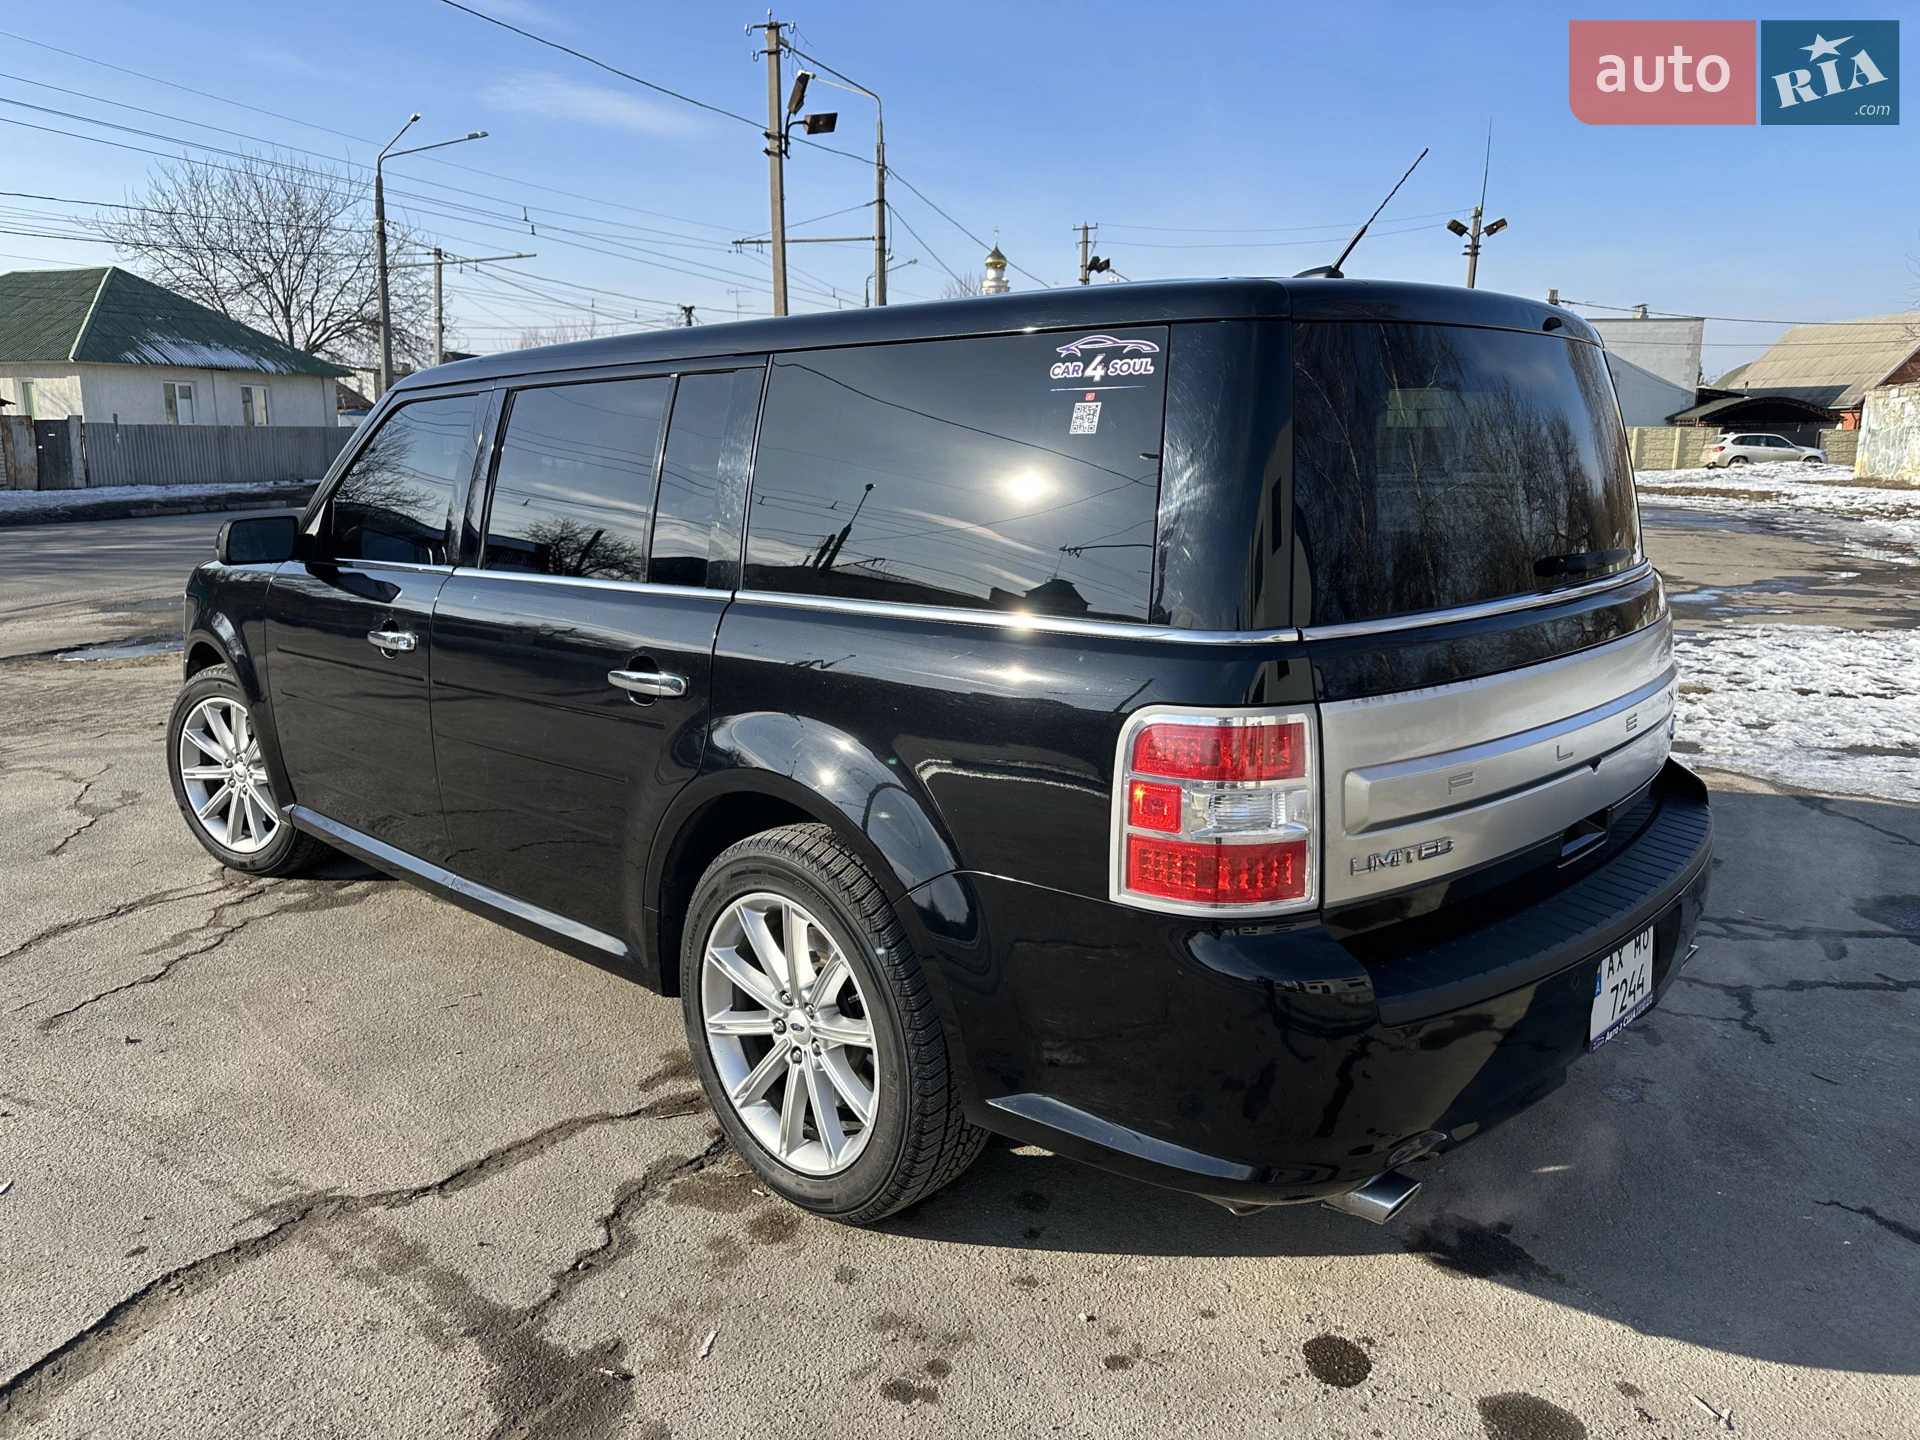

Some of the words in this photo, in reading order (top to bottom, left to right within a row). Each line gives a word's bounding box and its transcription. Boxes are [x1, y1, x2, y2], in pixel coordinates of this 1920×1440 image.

[1050, 362, 1083, 379] CAR
[1083, 353, 1107, 382] 4
[1107, 358, 1154, 376] SOUL
[1350, 836, 1455, 877] LIMITED
[1610, 963, 1645, 1021] 7244
